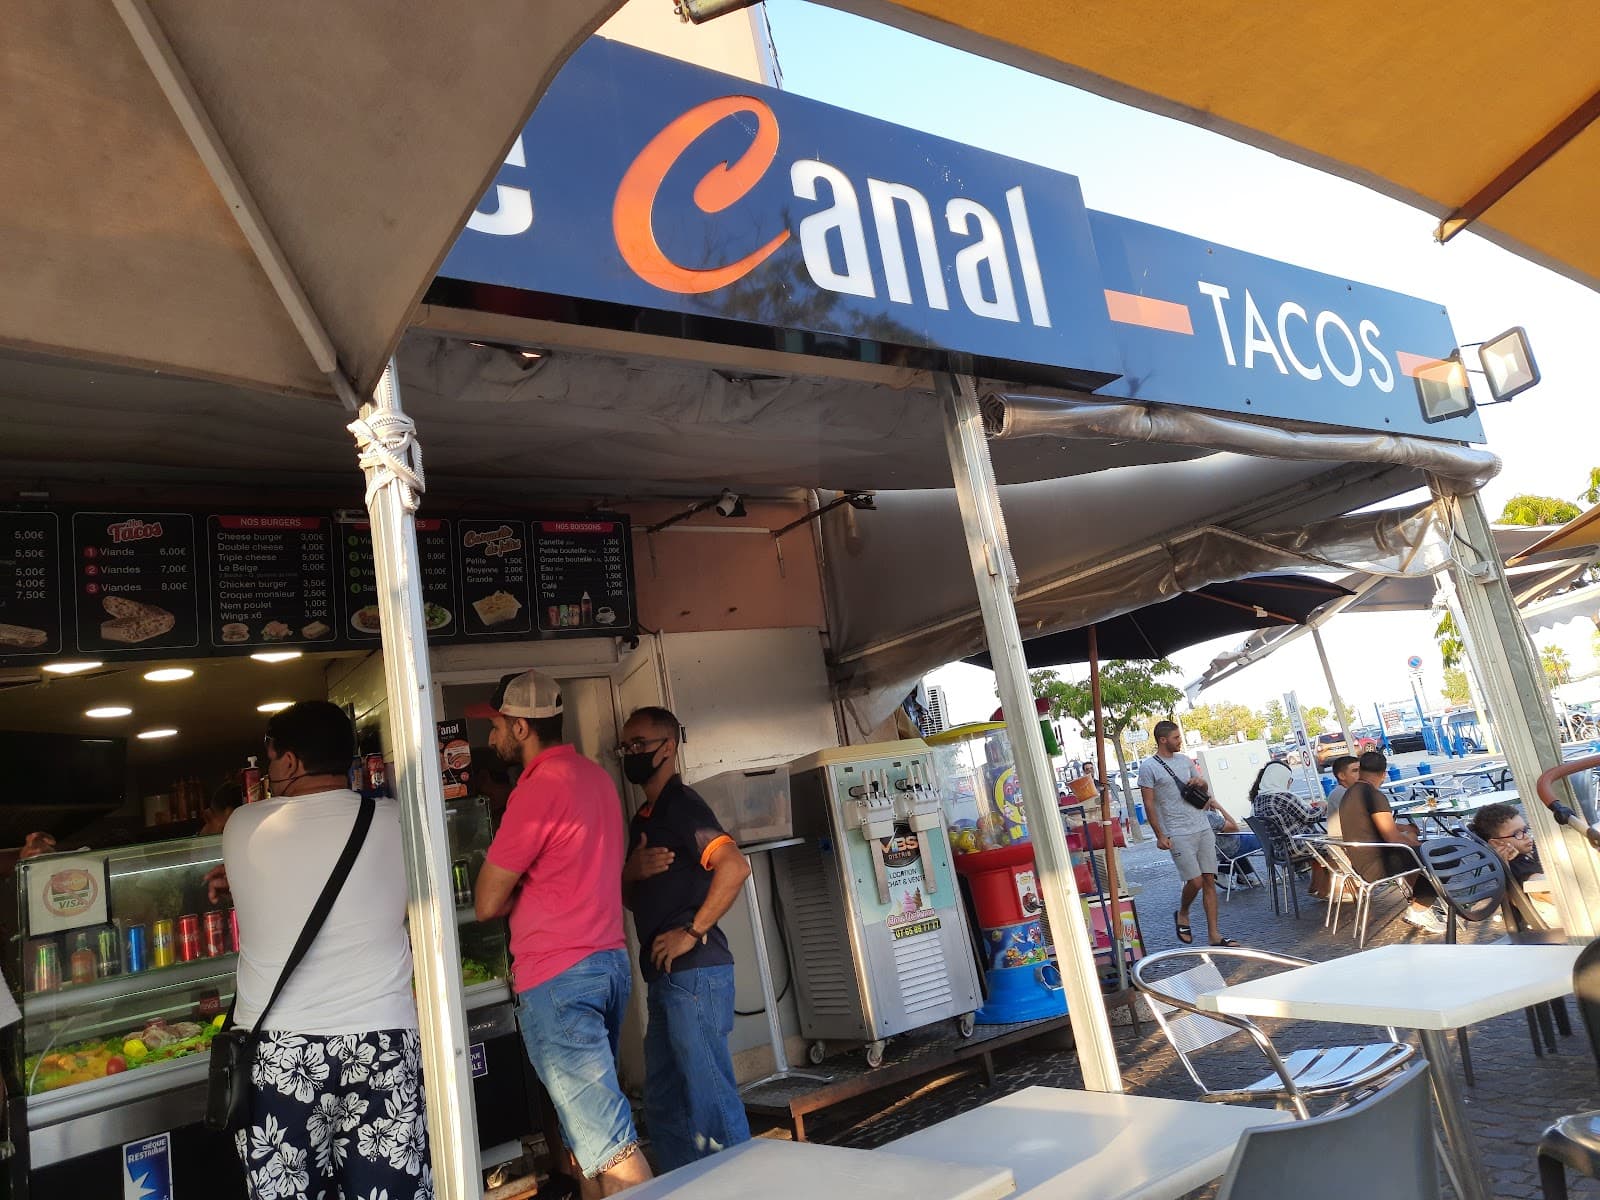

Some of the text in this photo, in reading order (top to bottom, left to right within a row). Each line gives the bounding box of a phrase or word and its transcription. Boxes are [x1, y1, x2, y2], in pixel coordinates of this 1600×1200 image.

[612, 94, 1052, 329] Canal
[1197, 280, 1396, 393] TACOS
[240, 518, 302, 527] NOS BURGERS
[14, 530, 45, 541] 5,00€
[107, 522, 163, 543] Tacos
[217, 532, 325, 543] Cheese burger 3,00€
[100, 547, 135, 556] Viande
[160, 547, 187, 557] 6,00€
[217, 542, 325, 552] Double cheese 4,00€
[15, 549, 46, 559] 5,50€
[218, 553, 325, 562] Triple cheese 5,00€
[540, 556, 565, 564] Grande
[15, 568, 46, 578] 5,00€
[100, 565, 141, 574] Viandes
[160, 565, 187, 574] 7,00€
[218, 563, 325, 573] Le Belge 5,00€
[15, 579, 46, 589] 4,00€
[466, 575, 494, 583] Grande
[101, 583, 142, 592] Viandes
[161, 582, 188, 591] 8,00€
[219, 580, 256, 589] Chicken
[258, 580, 288, 590] burger
[16, 591, 47, 601] 7,50€
[219, 589, 327, 600] Croque monsieur 2,50€
[220, 599, 328, 611] Nem poulet 1,00€
[220, 612, 249, 621] Wings
[304, 609, 328, 618] 3,50€
[439, 723, 460, 736] anal
[888, 880, 902, 888] CHAT
